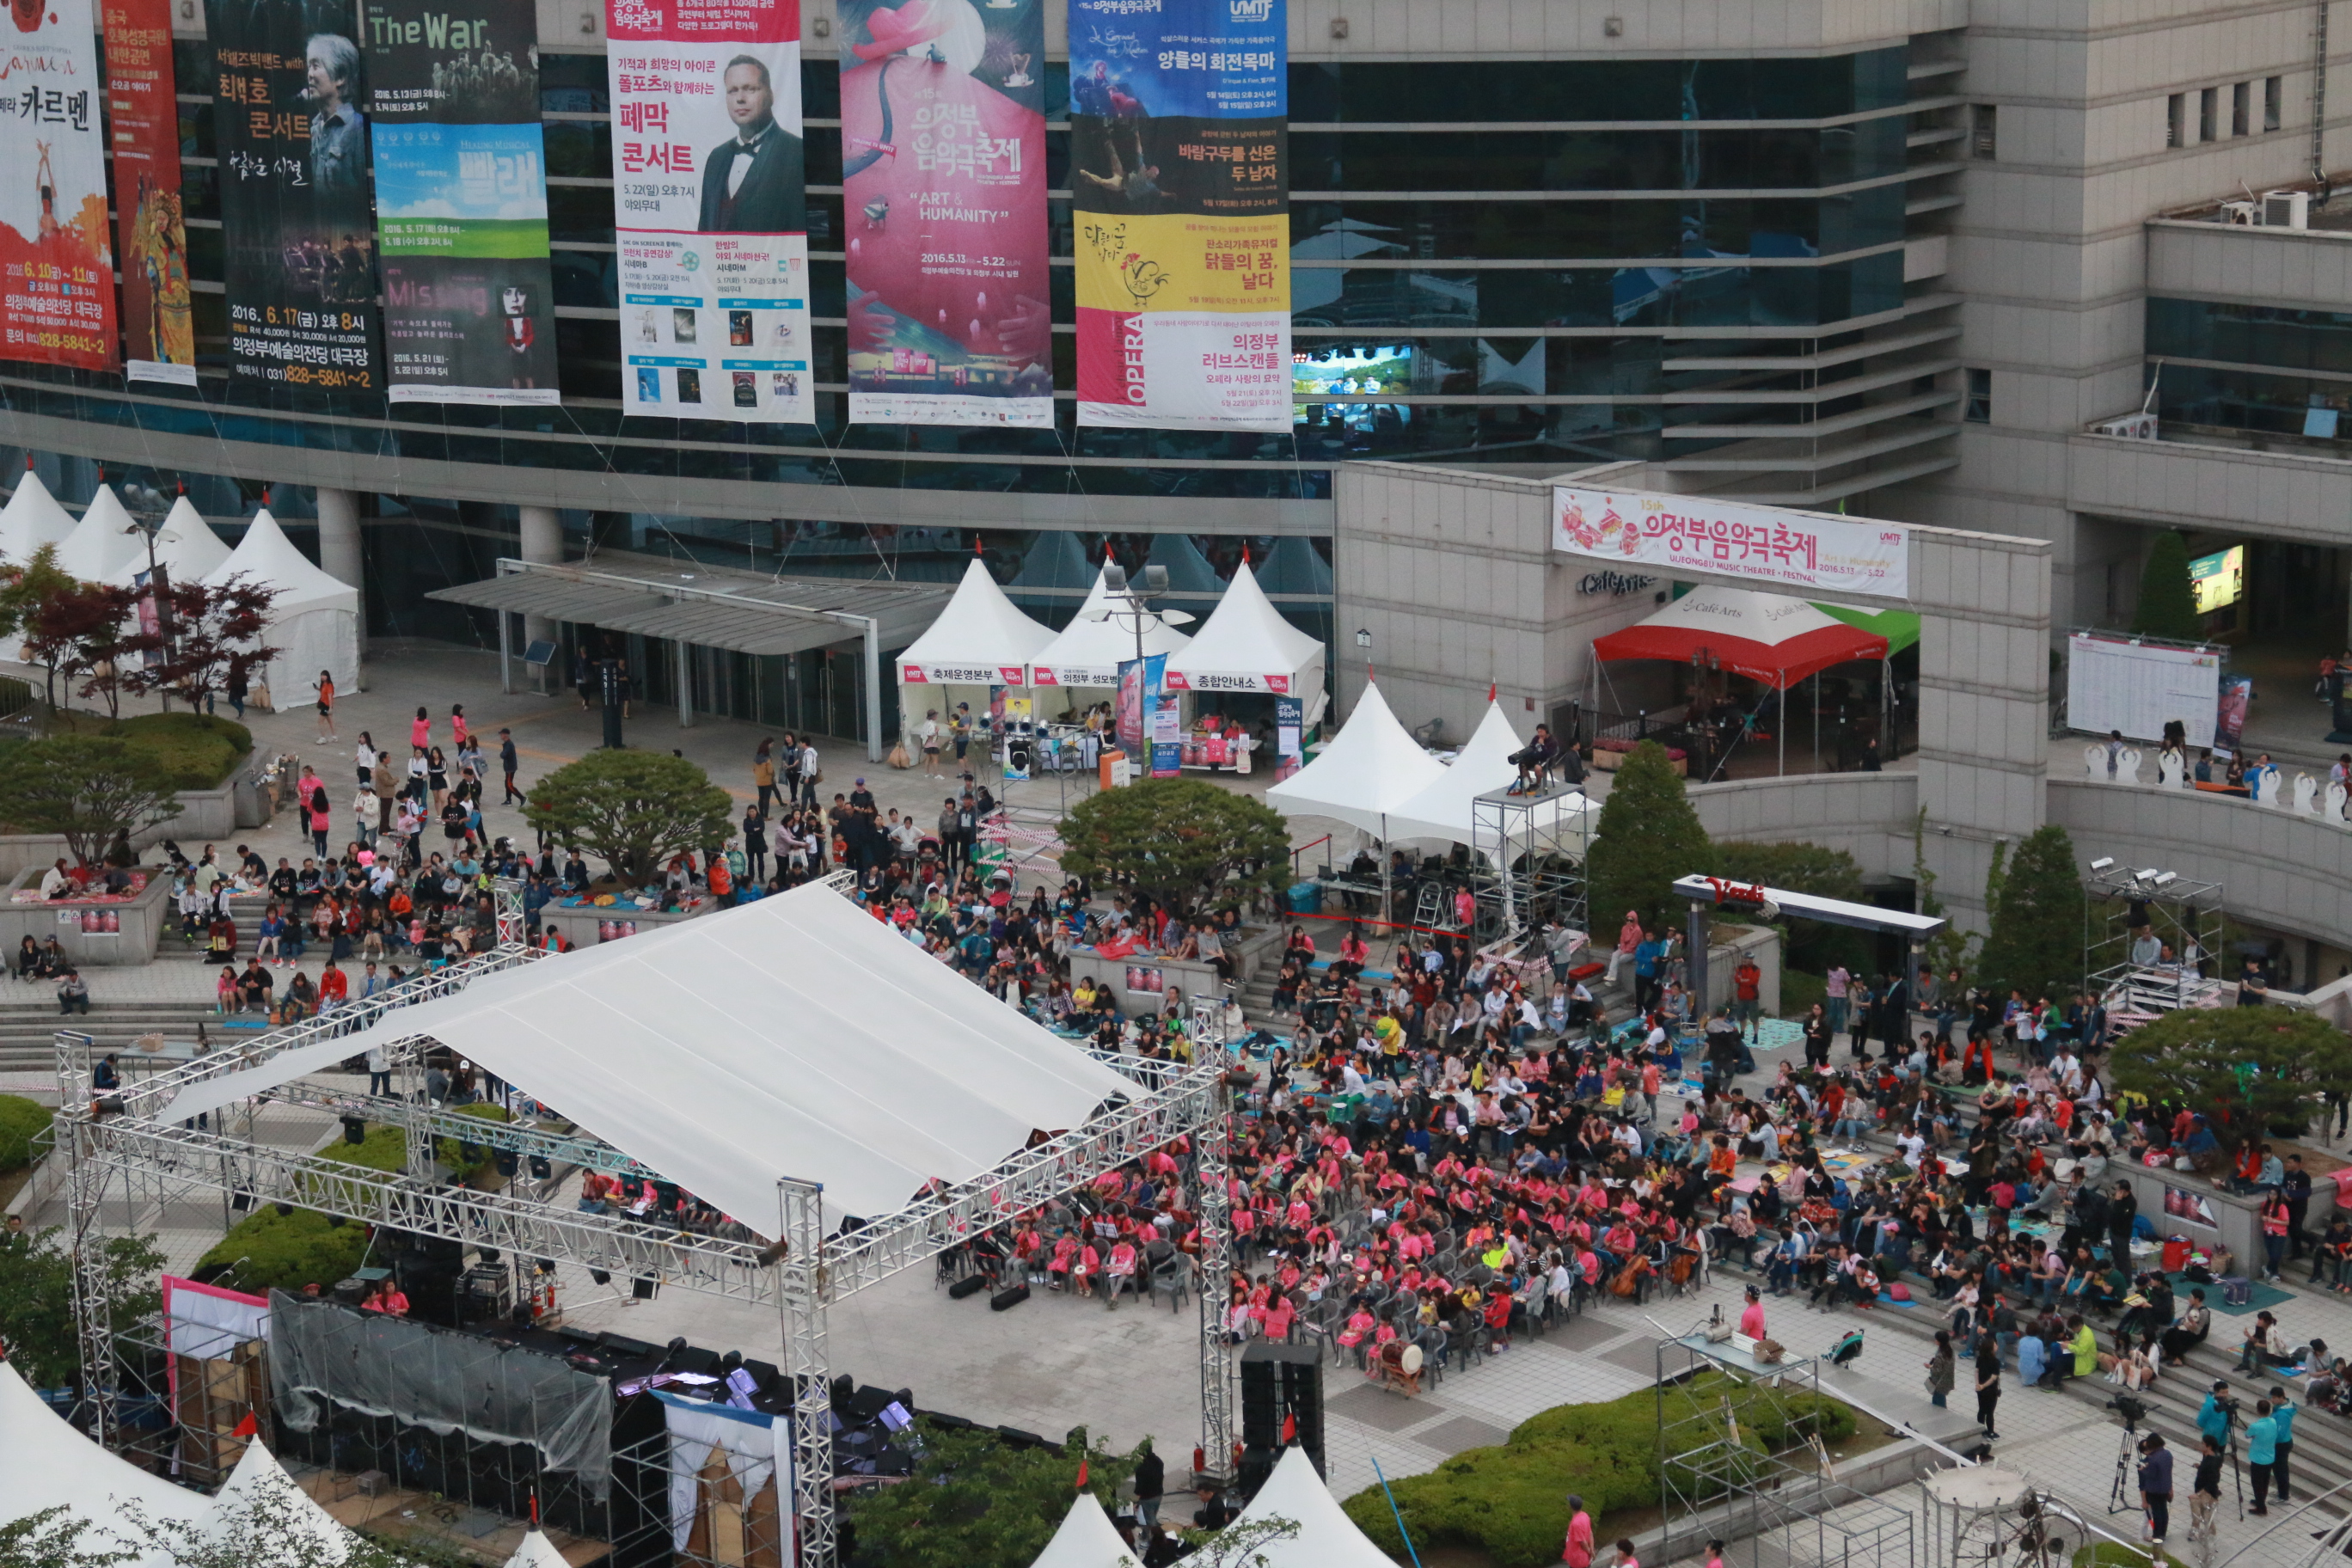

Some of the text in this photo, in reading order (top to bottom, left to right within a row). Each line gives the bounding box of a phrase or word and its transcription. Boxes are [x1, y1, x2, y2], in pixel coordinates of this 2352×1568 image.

[107, 9, 127, 25] 중국
[614, 8, 663, 29] 음악극축제
[677, 9, 750, 19] 공연부터 전시까지
[369, 12, 488, 50] The War
[677, 21, 698, 31] 다양한
[701, 21, 732, 30] 프로그램이
[108, 47, 151, 65] 내한공연
[285, 57, 303, 70] with
[1158, 50, 1276, 71] 양들의 회전목마
[618, 58, 716, 73] 기적과 희망의 아이콘
[111, 79, 151, 93] 손오공 이야기
[219, 74, 271, 105] 최백호
[618, 74, 715, 95] 폴포츠와 함께하는
[20, 85, 89, 132] 카르멘
[620, 101, 670, 134] 폐막
[911, 103, 980, 139] 의정부
[249, 112, 310, 141] 콘서트
[622, 142, 695, 174] 콘서트
[911, 131, 1021, 179] 음악극축제
[1179, 144, 1277, 162] 바람구두를 신은
[457, 151, 540, 205] 빨래
[1232, 164, 1277, 182] 두 남자
[662, 185, 679, 197] 오후
[680, 187, 695, 198] 7시
[953, 192, 963, 205] &
[625, 199, 660, 212] 야외무대
[715, 241, 738, 250] 한밤의
[1206, 238, 1278, 250] 판소리가족뮤지컬
[623, 248, 673, 259] 브런치 공연감상!
[715, 252, 732, 260] 야외
[1205, 253, 1252, 271] 닭들의
[624, 259, 647, 269] 시네마B
[716, 263, 746, 273] 시네마M
[1242, 272, 1275, 291] 날다
[75, 301, 103, 319] 대극장
[232, 304, 261, 323] 2016.
[322, 314, 339, 330] 오후
[340, 312, 364, 331] 8시
[7, 328, 24, 343] 문의
[1233, 334, 1279, 351] 의정부
[232, 336, 369, 367] 의정부예술의전당 대극장
[1124, 312, 1147, 404] OPERA
[1203, 352, 1279, 370] 러브스캔들
[236, 364, 260, 377] 예매처
[1206, 374, 1280, 384] 오페라 사랑의 묘약
[1640, 499, 1664, 511] 15th
[1642, 513, 1816, 570] 의정부음악극축제
[1669, 554, 1816, 584] UIJEONGBU MUSIC THEATRE FESTIVAL
[1695, 603, 1743, 618] Café Arts
[933, 669, 994, 681] 축제운영본부
[1063, 674, 1089, 683] 의정부
[1197, 675, 1257, 689] 종합안내소
